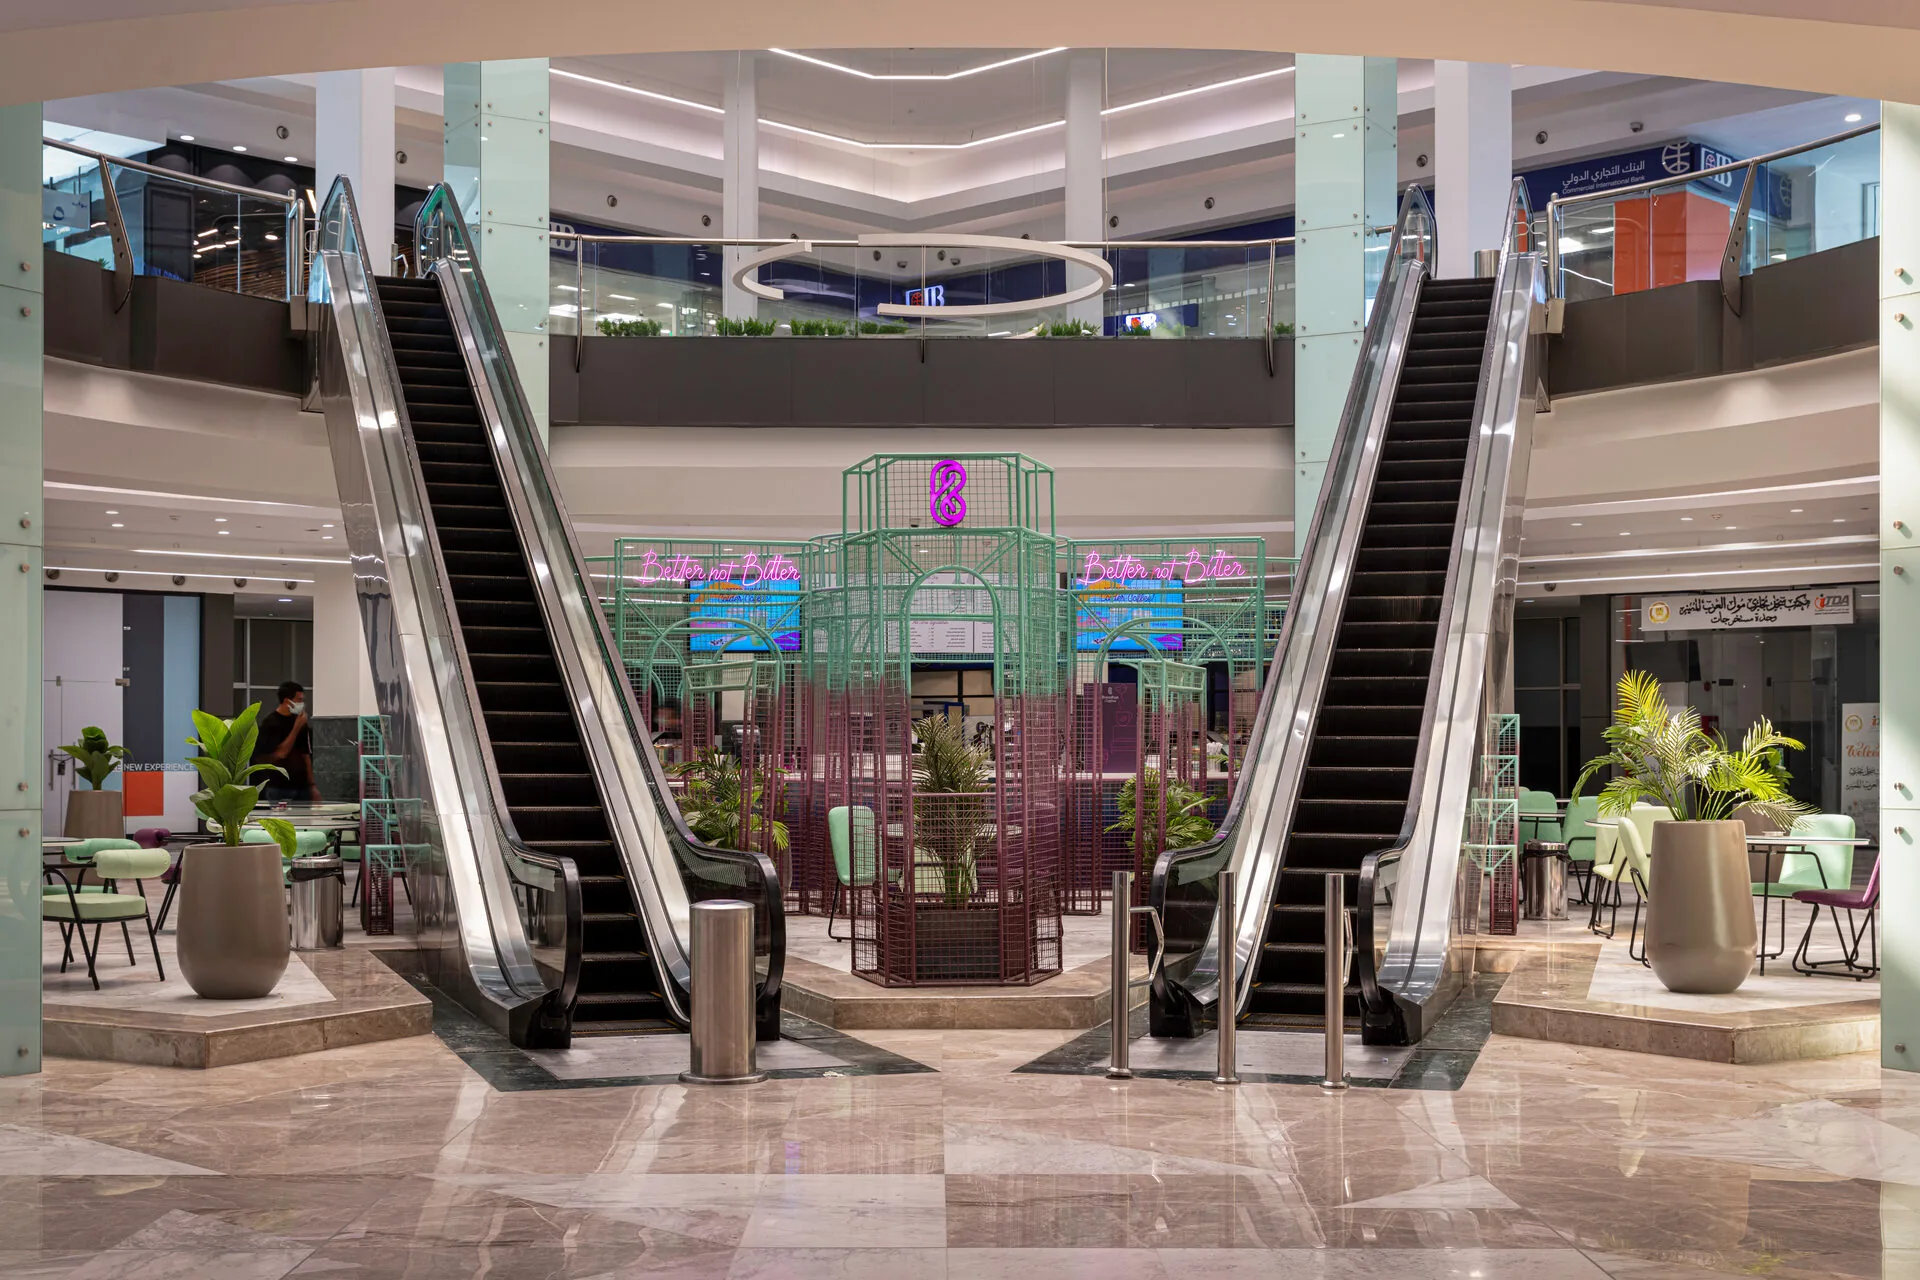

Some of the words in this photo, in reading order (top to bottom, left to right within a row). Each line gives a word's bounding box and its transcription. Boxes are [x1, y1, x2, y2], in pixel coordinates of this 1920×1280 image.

[1591, 165, 1620, 182] التجاري
[1622, 160, 1645, 174] البنك
[1562, 170, 1589, 188] الدولي
[1562, 184, 1595, 195] Commercial
[1596, 176, 1630, 189] International
[1630, 175, 1645, 184] Bank
[634, 549, 706, 585] Better
[708, 561, 740, 582] not
[742, 551, 801, 586] Bitter
[1078, 550, 1149, 586] Better
[1150, 558, 1182, 581] not
[1182, 548, 1246, 584] Bitter
[1702, 596, 1726, 614] العرب
[1727, 596, 1746, 614] مول
[1754, 612, 1777, 622] وحدة
[123, 763, 143, 772] NEW
[144, 763, 195, 772] EXPERIENCE
